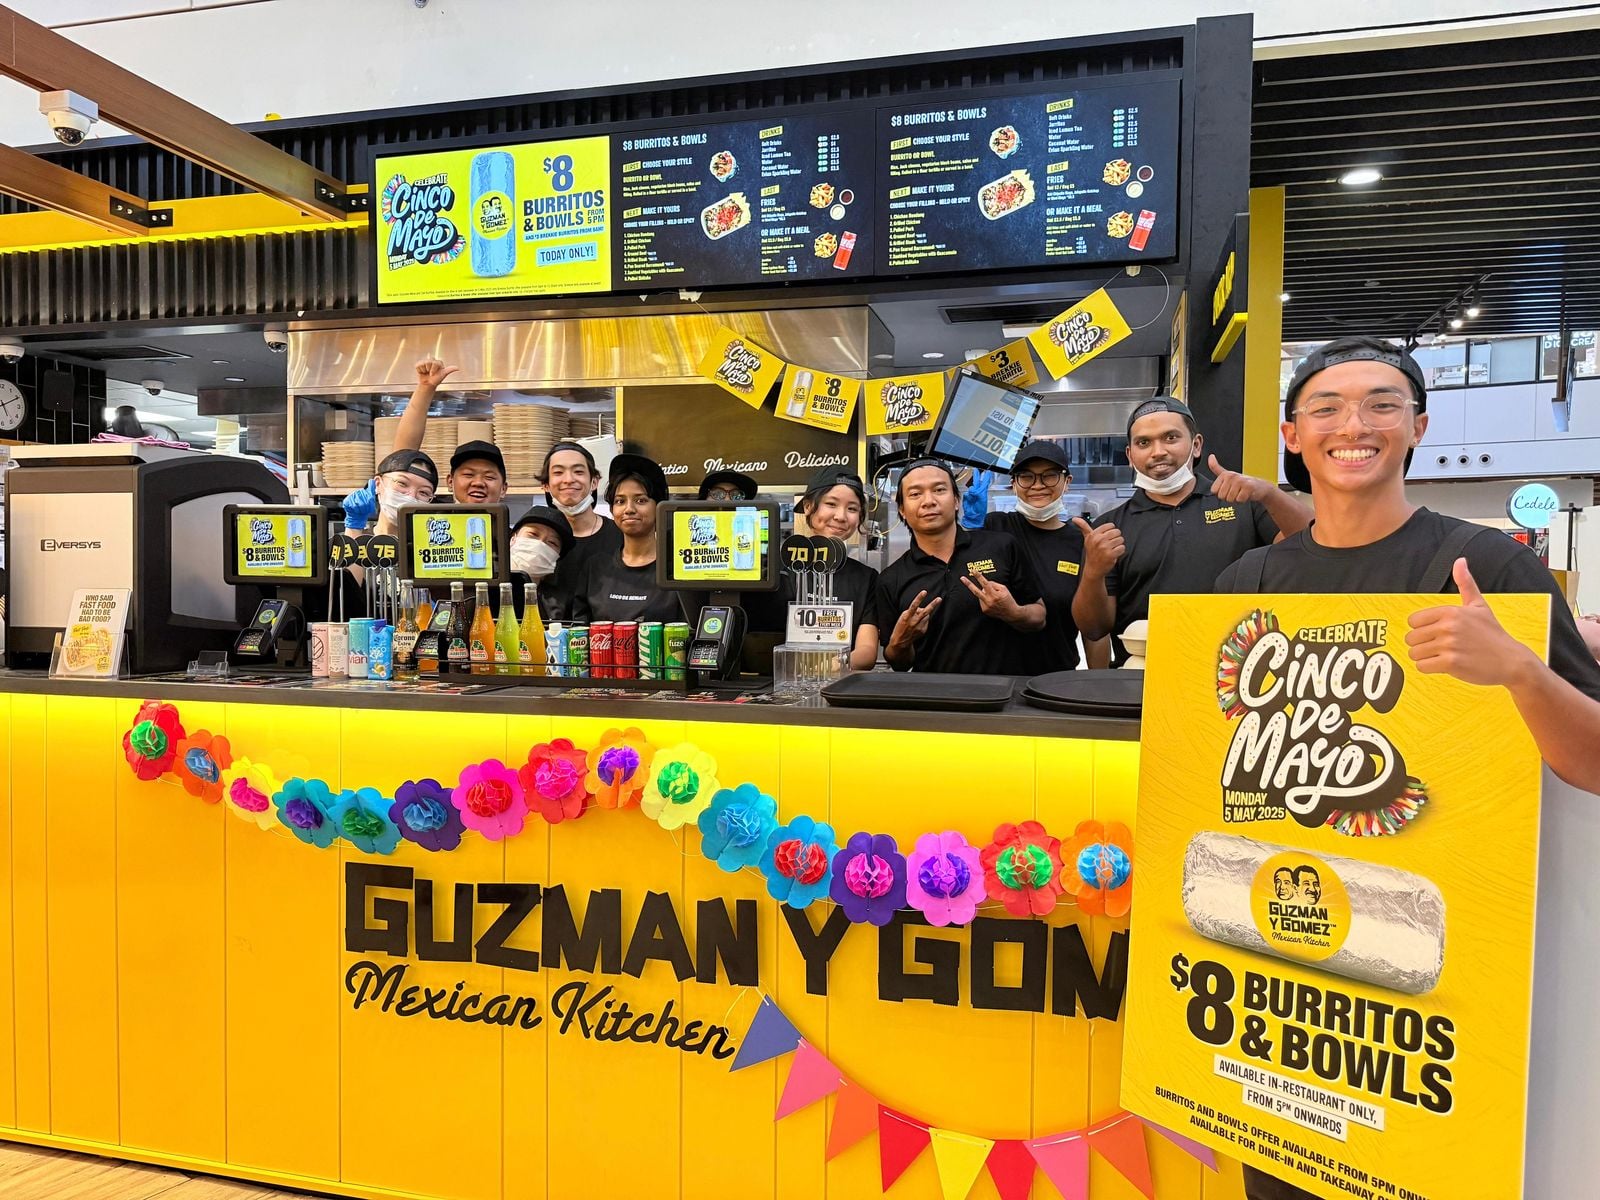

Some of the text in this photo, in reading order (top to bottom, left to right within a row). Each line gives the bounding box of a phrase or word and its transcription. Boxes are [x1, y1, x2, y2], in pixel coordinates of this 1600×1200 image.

[891, 107, 987, 127] $8 BURRITOS & BOWLS
[622, 133, 707, 151] $8 BURRITOS & BOWLS
[913, 136, 934, 145] CHOOSE
[935, 135, 951, 143] YOUR
[952, 133, 969, 142] STYLE
[642, 157, 693, 168] CHOOSE YOUR STYLE
[414, 173, 448, 186] CELEBRATE
[543, 154, 574, 192] $8
[1046, 175, 1064, 184] FRIES
[912, 184, 954, 194] MAKE IT YOURS
[524, 190, 604, 216] BURRITOS
[643, 207, 656, 215] MAKE
[664, 205, 680, 213] YOURS
[761, 198, 776, 206] FRIES
[1046, 208, 1055, 216] OR
[1056, 207, 1072, 215] MAKE
[1074, 206, 1080, 214] IT
[1086, 204, 1103, 213] MEAL
[480, 213, 506, 224] GUZMAN
[588, 208, 604, 216] FROM
[523, 218, 534, 232] &
[536, 211, 584, 230] BOWLS
[770, 228, 784, 236] MAKE
[785, 227, 790, 235] IT
[796, 226, 810, 234] MEAL
[540, 246, 594, 262] TODAY ONLY!
[990, 351, 1009, 368] $3
[990, 360, 1022, 380] BREKKIE
[825, 376, 842, 397] $8
[813, 394, 848, 406] BURRITOS
[820, 403, 845, 413] BOWLS
[703, 458, 768, 473] Mexicano
[784, 451, 850, 469] Delicioso
[1514, 496, 1556, 510] Cedele
[242, 548, 254, 562] $8
[419, 547, 464, 563] $8 BURRITOS
[439, 555, 464, 563] BOWLS
[679, 547, 729, 564] $8 BURRITOS
[702, 555, 729, 563] BOWLS
[788, 547, 809, 561] 70
[797, 610, 817, 627] 10
[1300, 620, 1387, 645] CELEBRATE
[1225, 790, 1268, 806] MONDAY
[1224, 806, 1285, 821] 5 MAY 2025
[1269, 901, 1328, 920] GUZMAN
[1269, 917, 1278, 930] Y
[344, 861, 1130, 1022] GUZMAN Y GOM
[1272, 932, 1330, 947] Mexican Kitchen
[1170, 952, 1236, 1046] $8
[346, 961, 735, 1060] Mexican Kitchen
[1243, 970, 1455, 1061] BURRITOS
[1240, 1015, 1453, 1114] & BOWLS
[1219, 1060, 1377, 1125] AVAILABLE IN-RESTAURANT ONLY,
[1247, 1089, 1342, 1135] FROM 5PM ONWARDS
[1155, 1086, 1195, 1111] BURRITOS
[1196, 1104, 1215, 1118] AND
[1217, 1112, 1248, 1133] BOWLS
[1251, 1126, 1280, 1146] OFFER
[1282, 1139, 1335, 1170] AVAILABLE
[1338, 1160, 1368, 1184] FROM
[1371, 1176, 1396, 1195] 5PM
[1190, 1115, 1374, 1200] AVAILABLE FOR DINE-IN AND TAKEAWAY
